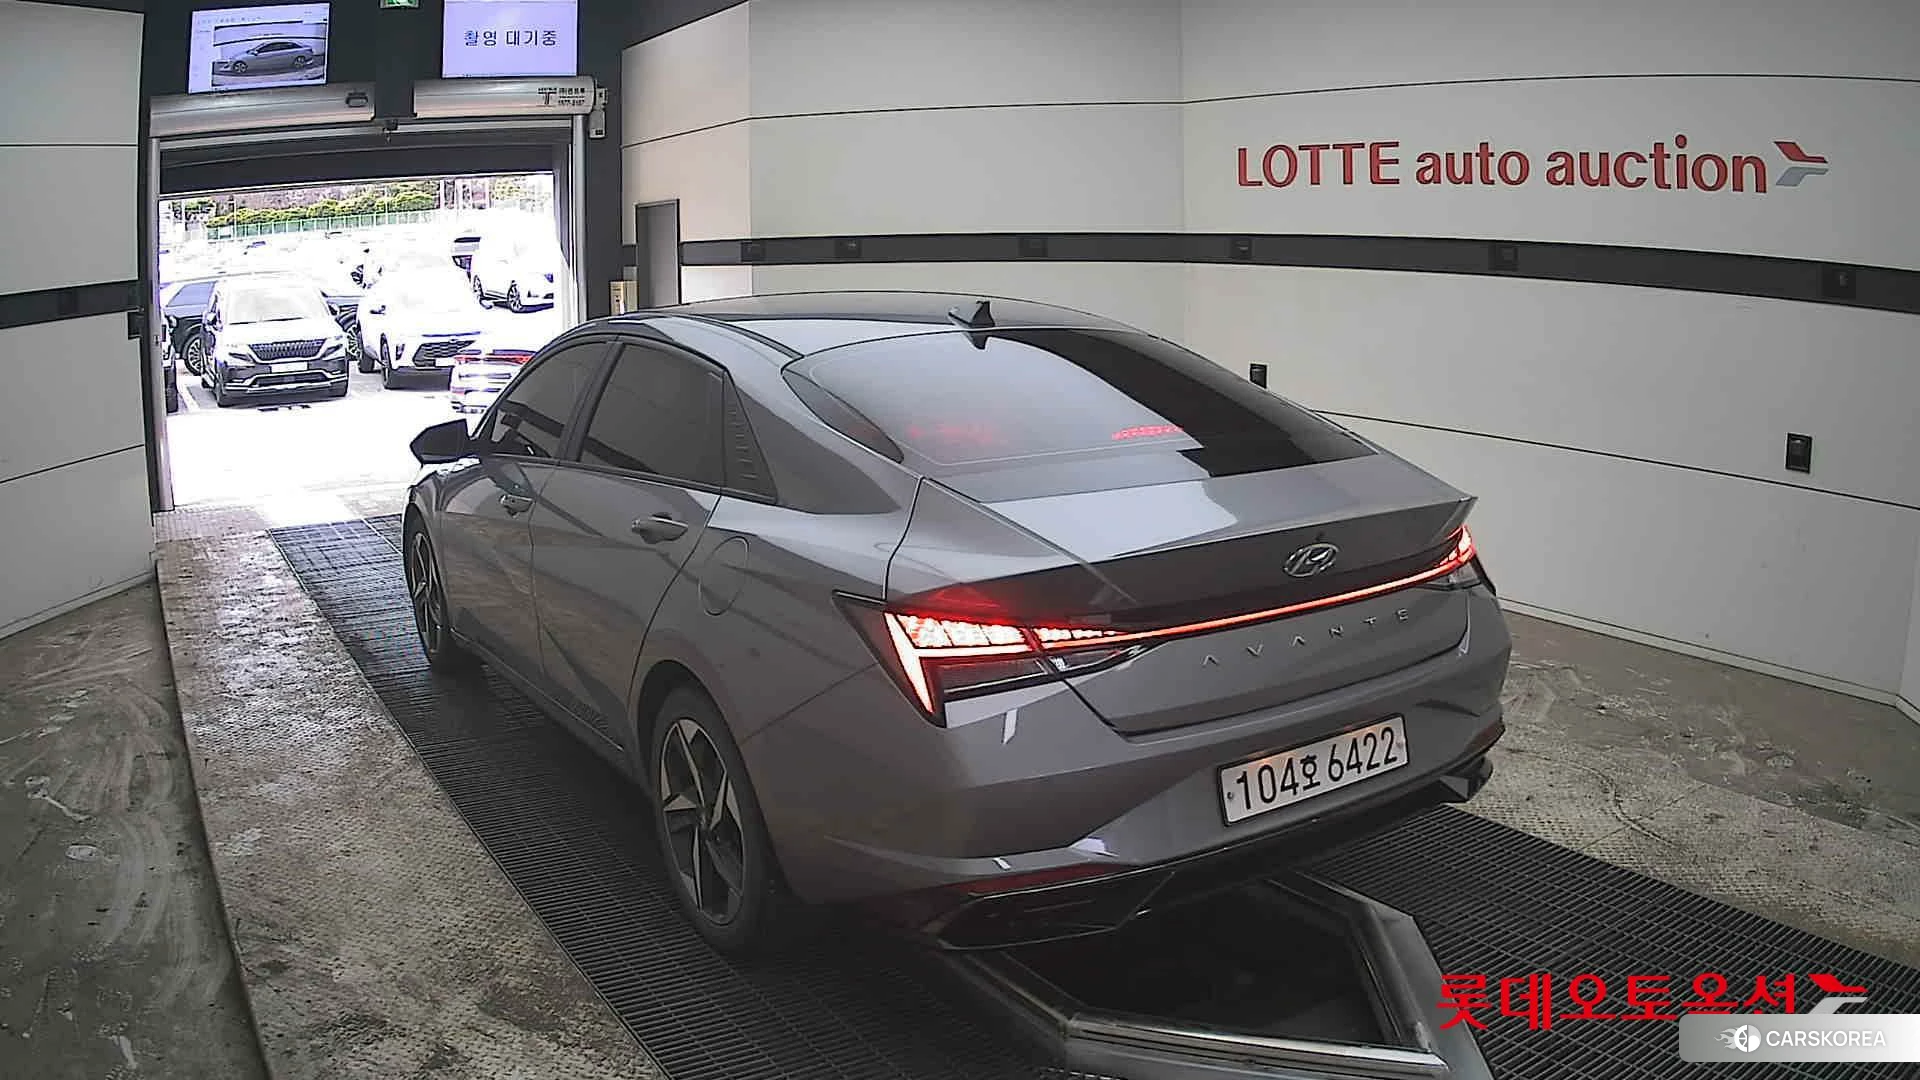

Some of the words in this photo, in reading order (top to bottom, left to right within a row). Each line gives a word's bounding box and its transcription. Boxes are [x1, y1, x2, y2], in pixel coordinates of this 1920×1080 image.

[464, 30, 497, 46] 촬영
[506, 30, 557, 46] 대기중
[1238, 141, 1399, 187] LOTTE
[1416, 142, 1530, 185] auto
[1546, 134, 1767, 193] auction
[1202, 608, 1409, 666] AVANTE
